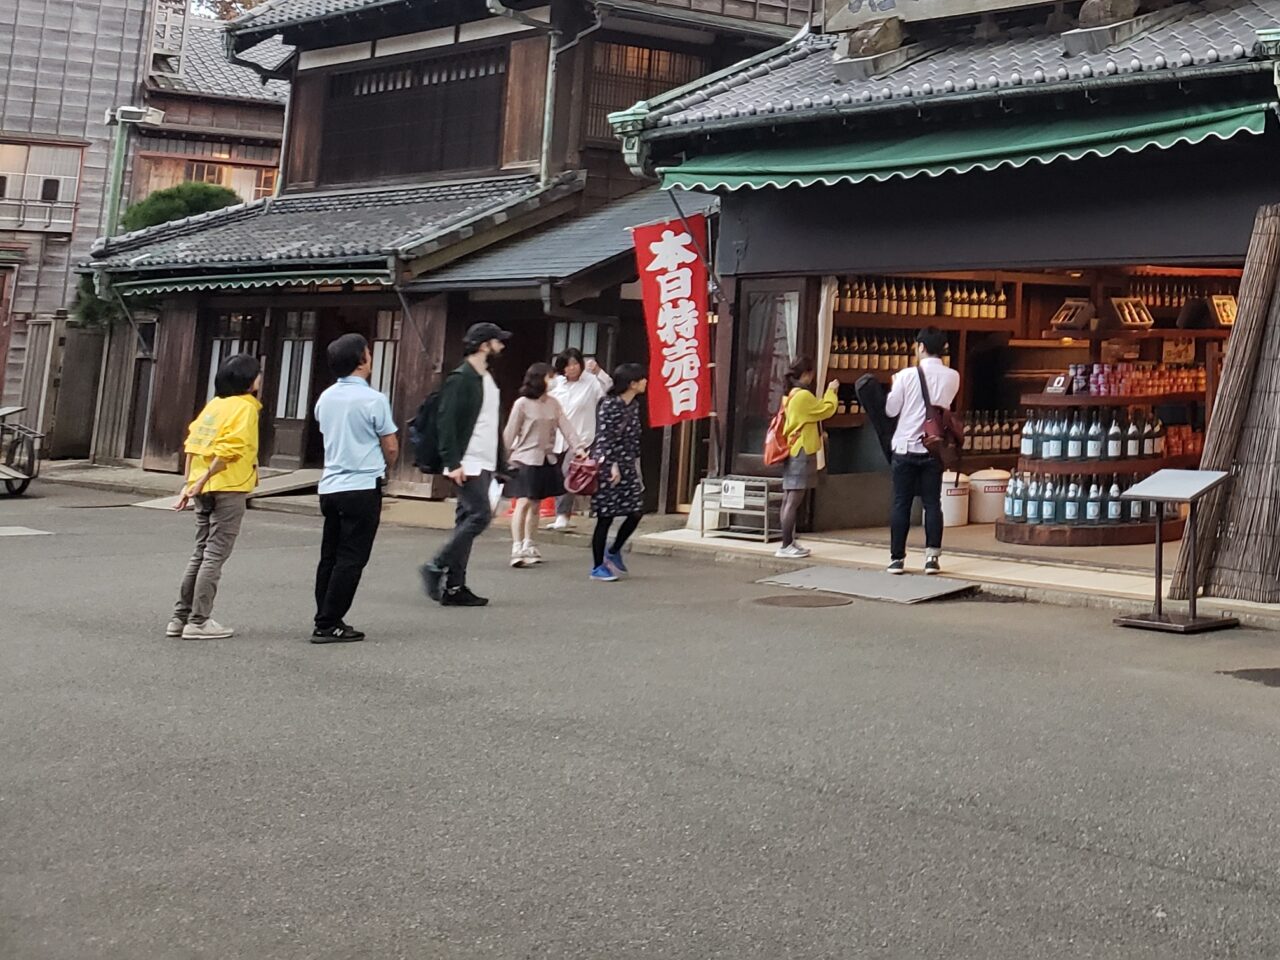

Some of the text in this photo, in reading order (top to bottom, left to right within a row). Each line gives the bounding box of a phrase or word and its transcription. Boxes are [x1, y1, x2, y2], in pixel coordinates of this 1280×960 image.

[646, 229, 699, 416] 本日特売日
[332, 628, 344, 637] N
